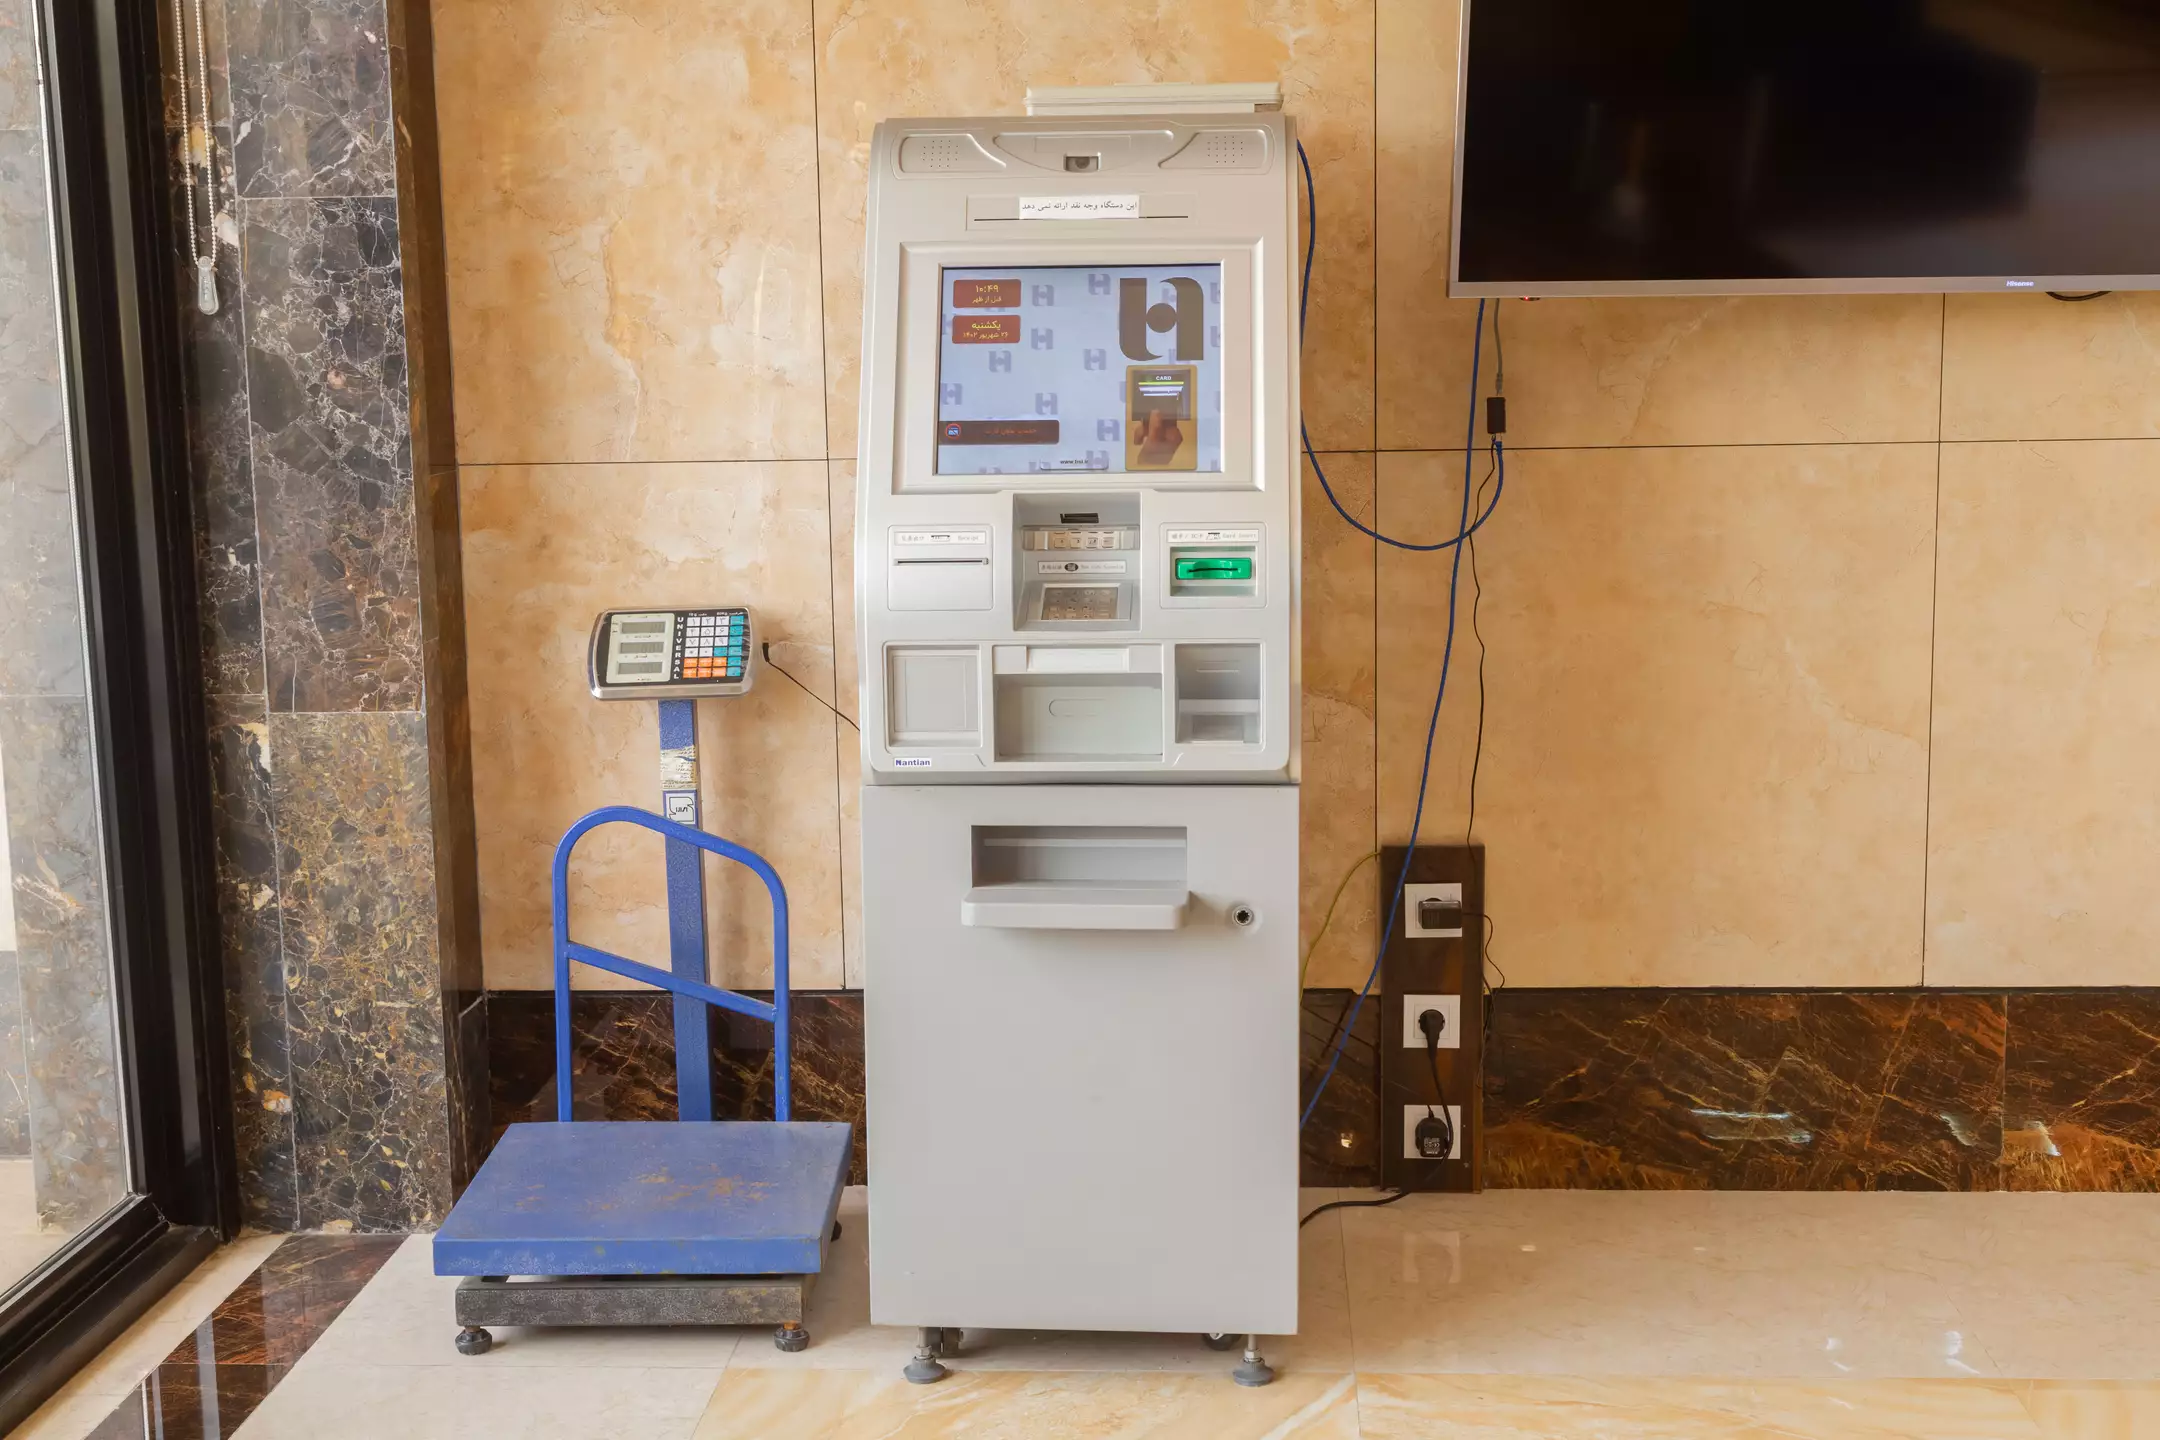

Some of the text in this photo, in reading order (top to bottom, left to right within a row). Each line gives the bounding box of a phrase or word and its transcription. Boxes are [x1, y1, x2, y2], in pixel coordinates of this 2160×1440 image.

[1038, 203, 1051, 211] نمی
[1101, 201, 1123, 209] دستگاه
[1126, 202, 1137, 211] این
[972, 295, 984, 304] ظهر
[971, 320, 1001, 331] یکشنبه
[979, 331, 1000, 340] شهریور
